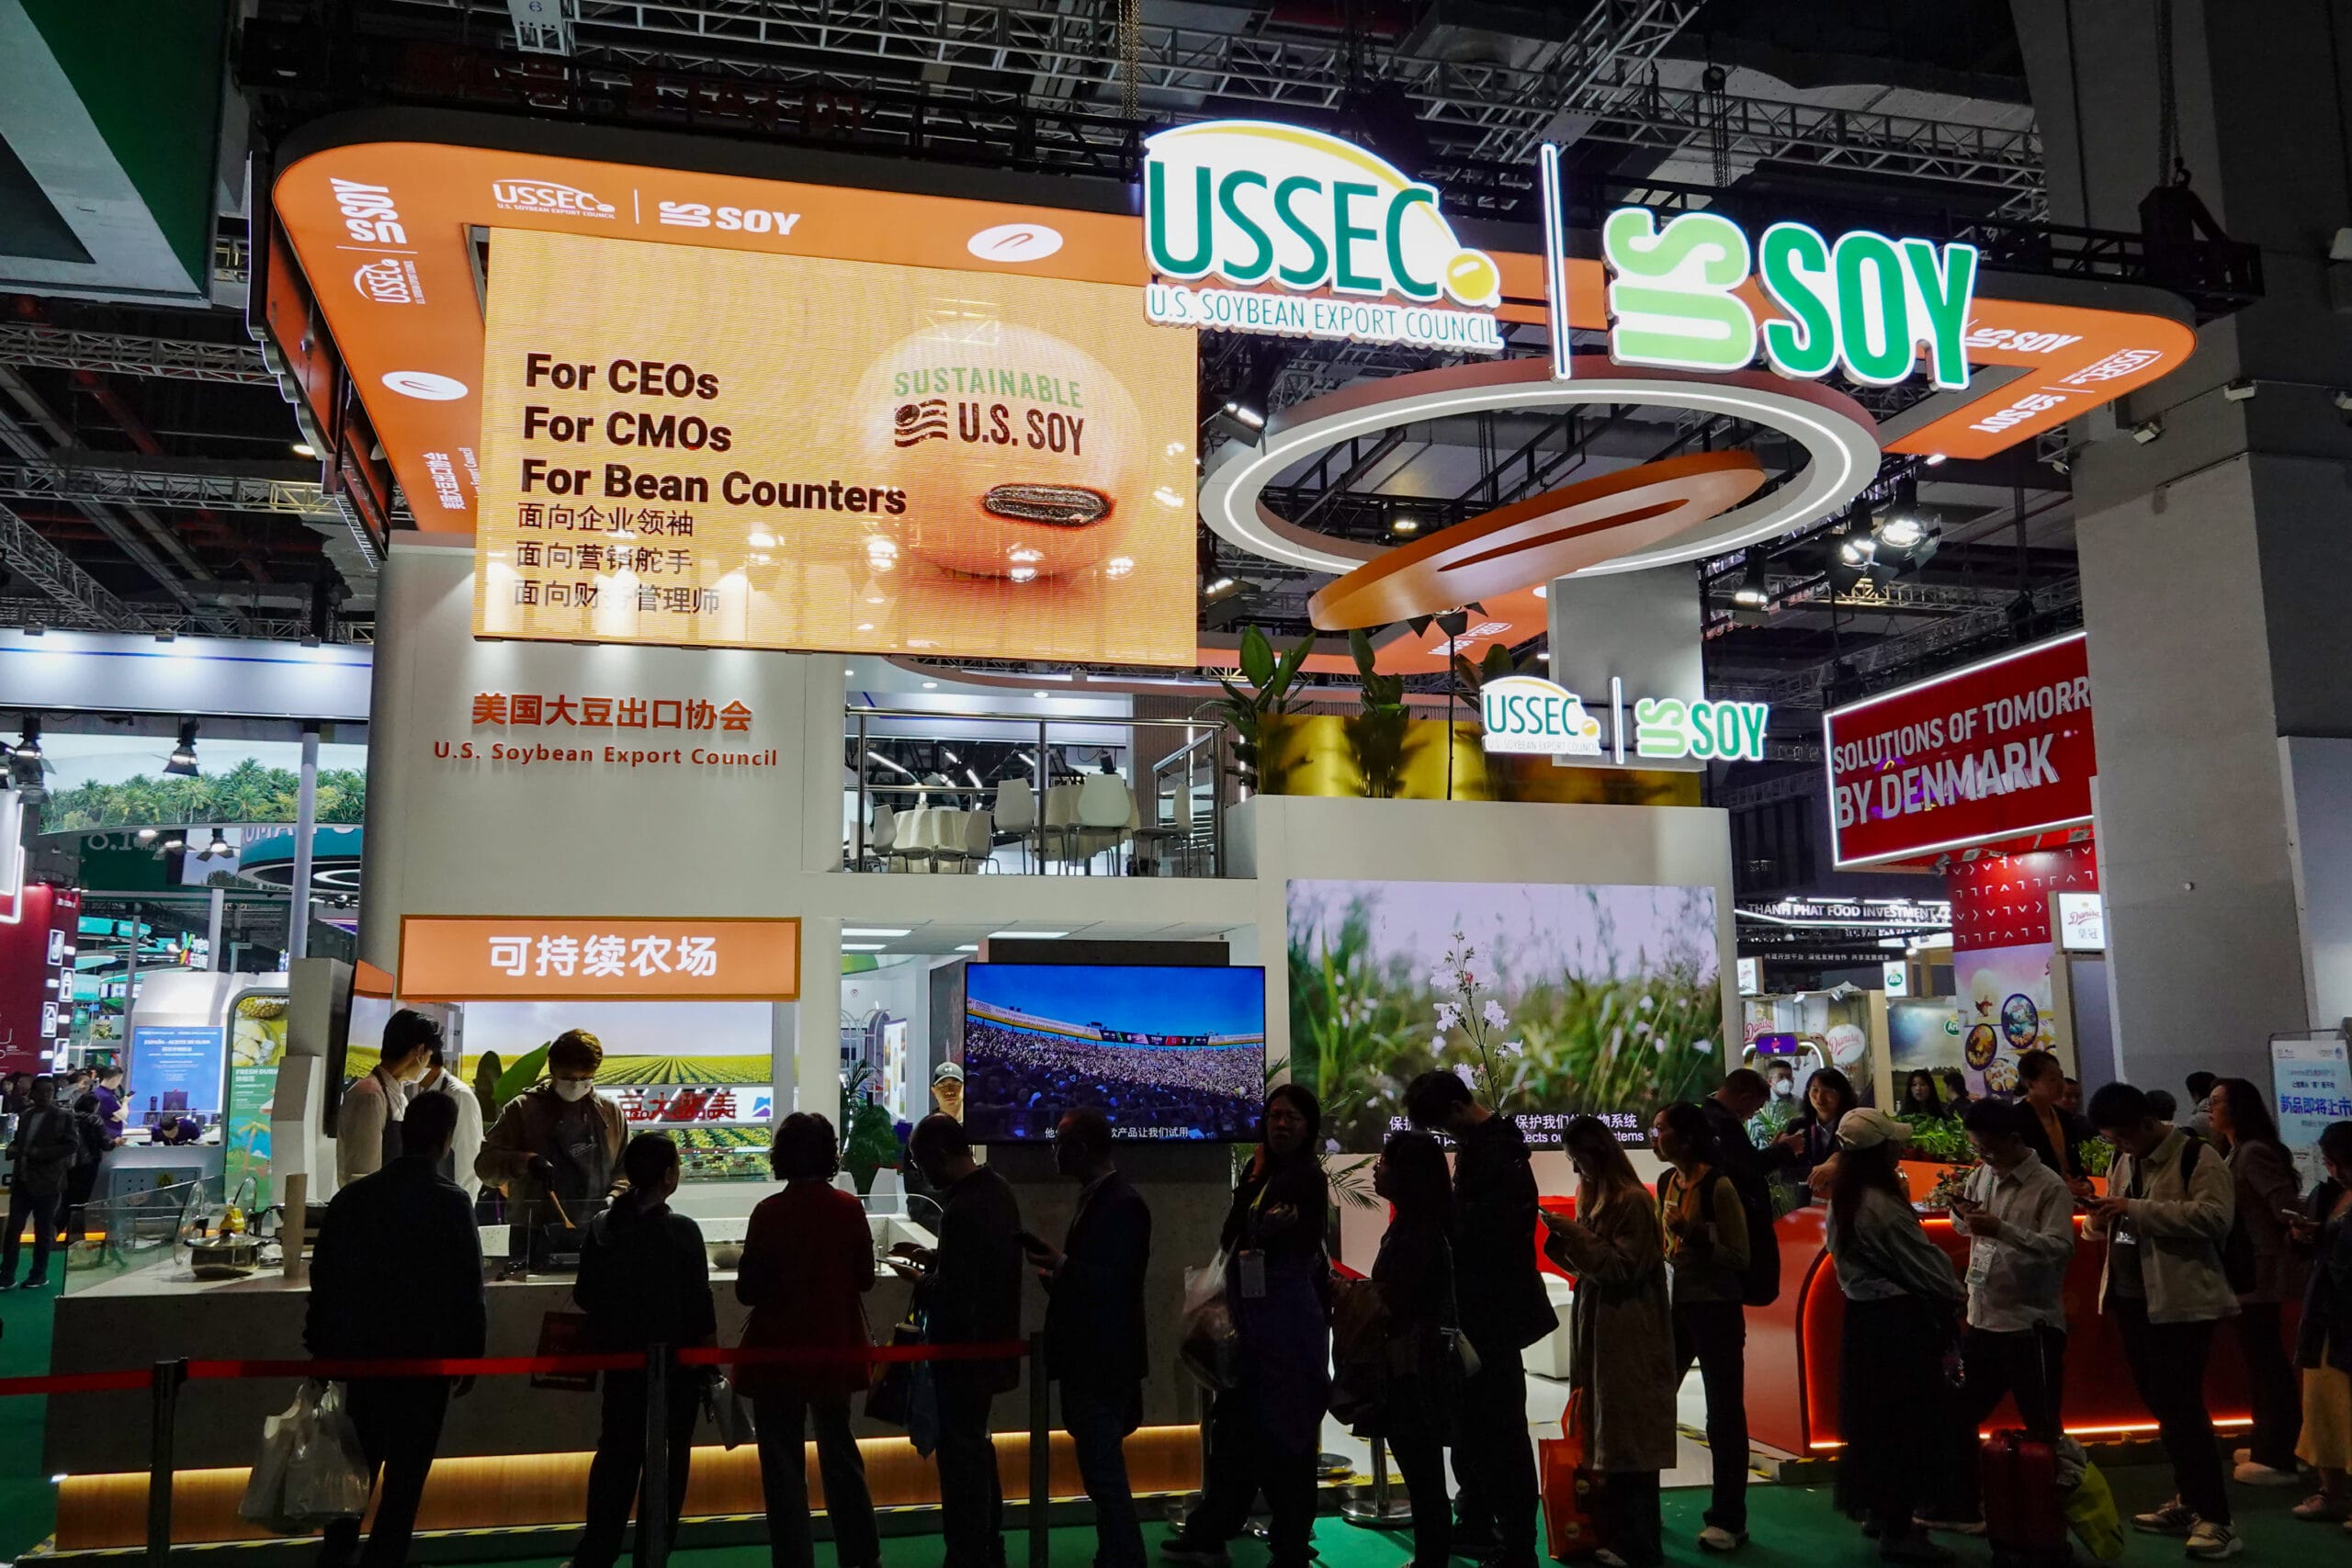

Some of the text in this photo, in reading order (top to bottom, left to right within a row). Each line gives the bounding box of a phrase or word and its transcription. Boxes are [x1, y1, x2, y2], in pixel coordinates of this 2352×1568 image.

[329, 177, 399, 221] SOY
[492, 183, 596, 213] USSEC
[715, 207, 801, 235] SOY
[497, 203, 514, 211] U.S.
[551, 209, 582, 218] EXPORT
[582, 211, 616, 221] COUNCIL
[1149, 161, 1439, 297] USSEC
[1150, 290, 1498, 345] U.S. SOYBEAN EXPORT COUNCIL
[1764, 227, 1978, 386] SOY
[526, 353, 719, 400] For CEOs
[894, 367, 1084, 409] SUSTAINABLE
[524, 406, 732, 452] For CMOs
[958, 401, 1085, 457] U.S. SOY
[521, 458, 908, 514] For Bean Counters
[517, 502, 695, 537] 面向企业领袖
[515, 540, 694, 575] 面向营销舵手
[514, 579, 720, 615] 面向财管理师
[472, 692, 752, 732] 美国大豆出口协会
[1487, 694, 1579, 737] USSEC
[1691, 703, 1765, 758] SOY
[1833, 675, 2092, 774] SOLUTIONS OF TOMORR
[434, 741, 778, 767] U.S. Soybean Export Council
[1836, 733, 2060, 829] BY DENMARK
[1748, 903, 1792, 916] THANH
[1793, 904, 1825, 917] PHAT
[1826, 904, 1861, 917] FOOD
[1862, 905, 1936, 919] INVESTMENT
[488, 934, 718, 977] 可持续农场
